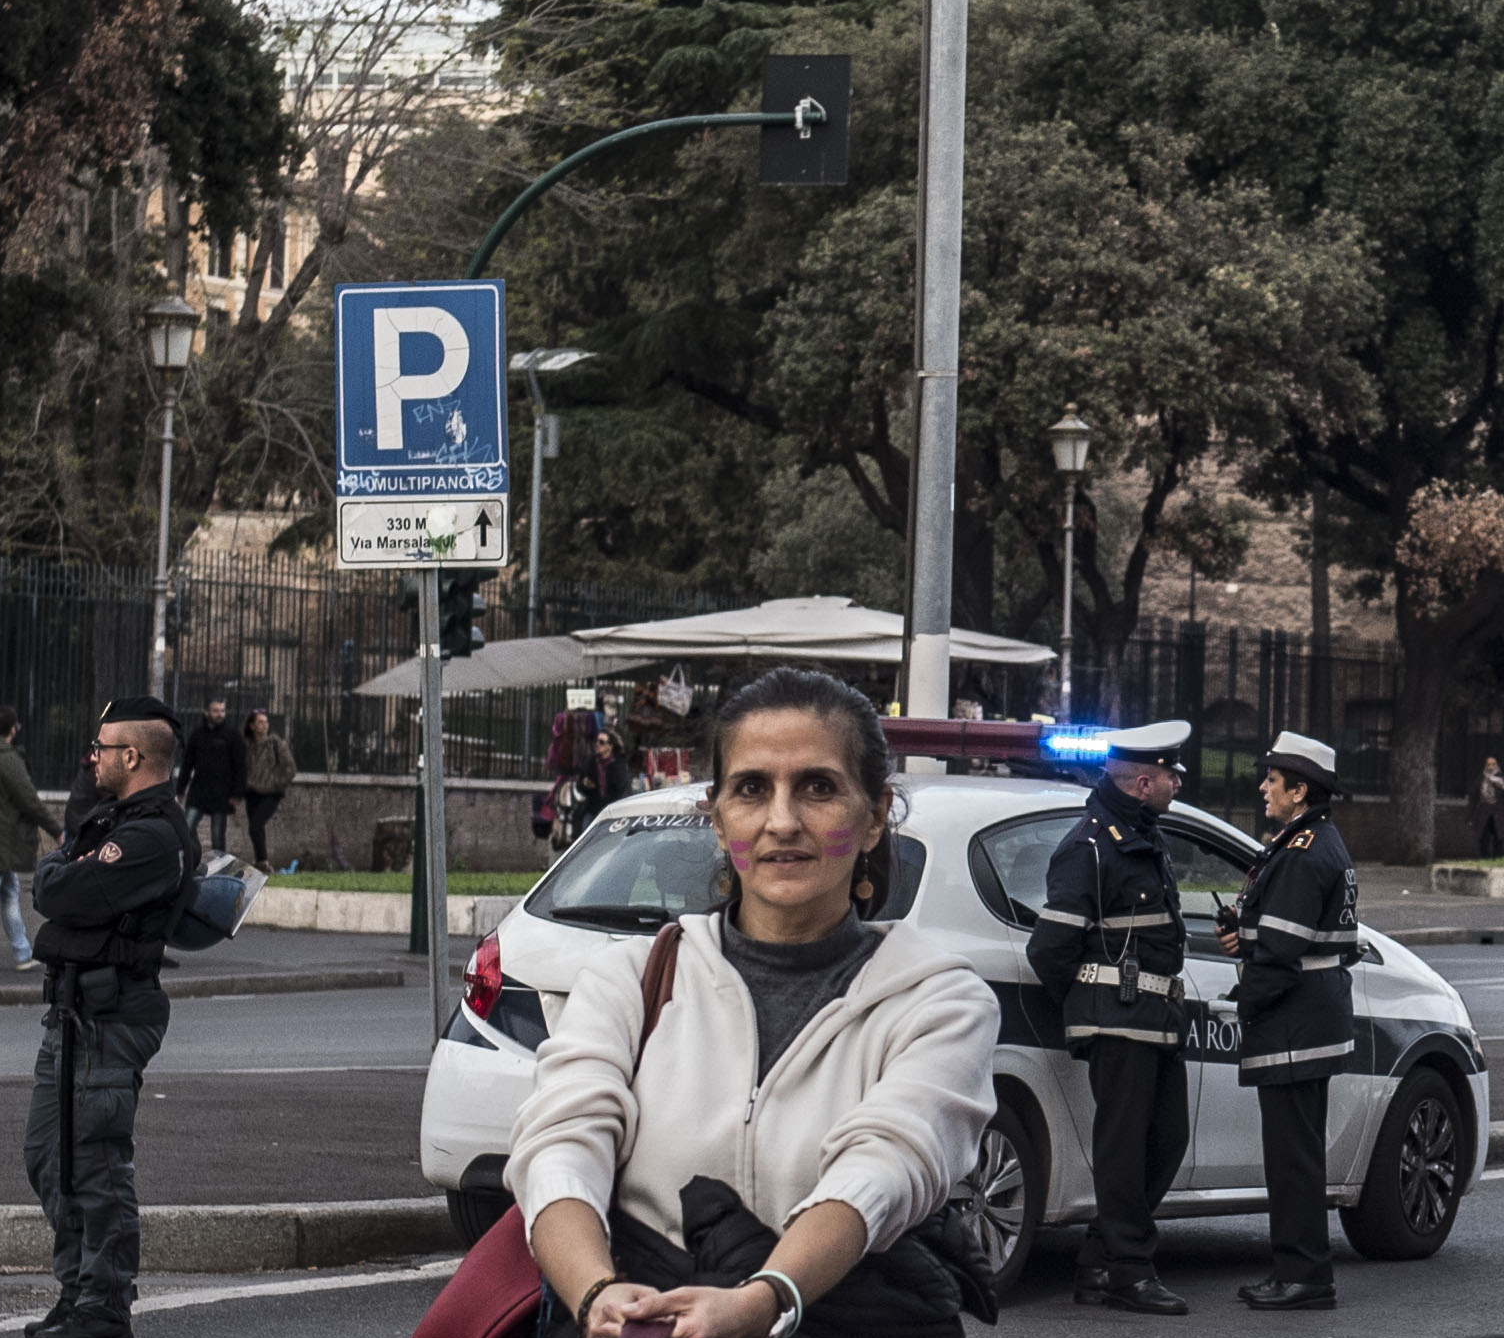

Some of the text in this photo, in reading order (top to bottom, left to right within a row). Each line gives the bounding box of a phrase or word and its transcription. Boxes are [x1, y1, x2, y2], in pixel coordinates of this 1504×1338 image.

[373, 307, 470, 450] P
[386, 517, 411, 531] 330
[350, 536, 372, 550] Via
[377, 536, 431, 550] Marsala
[631, 815, 705, 827] POLIZIA
